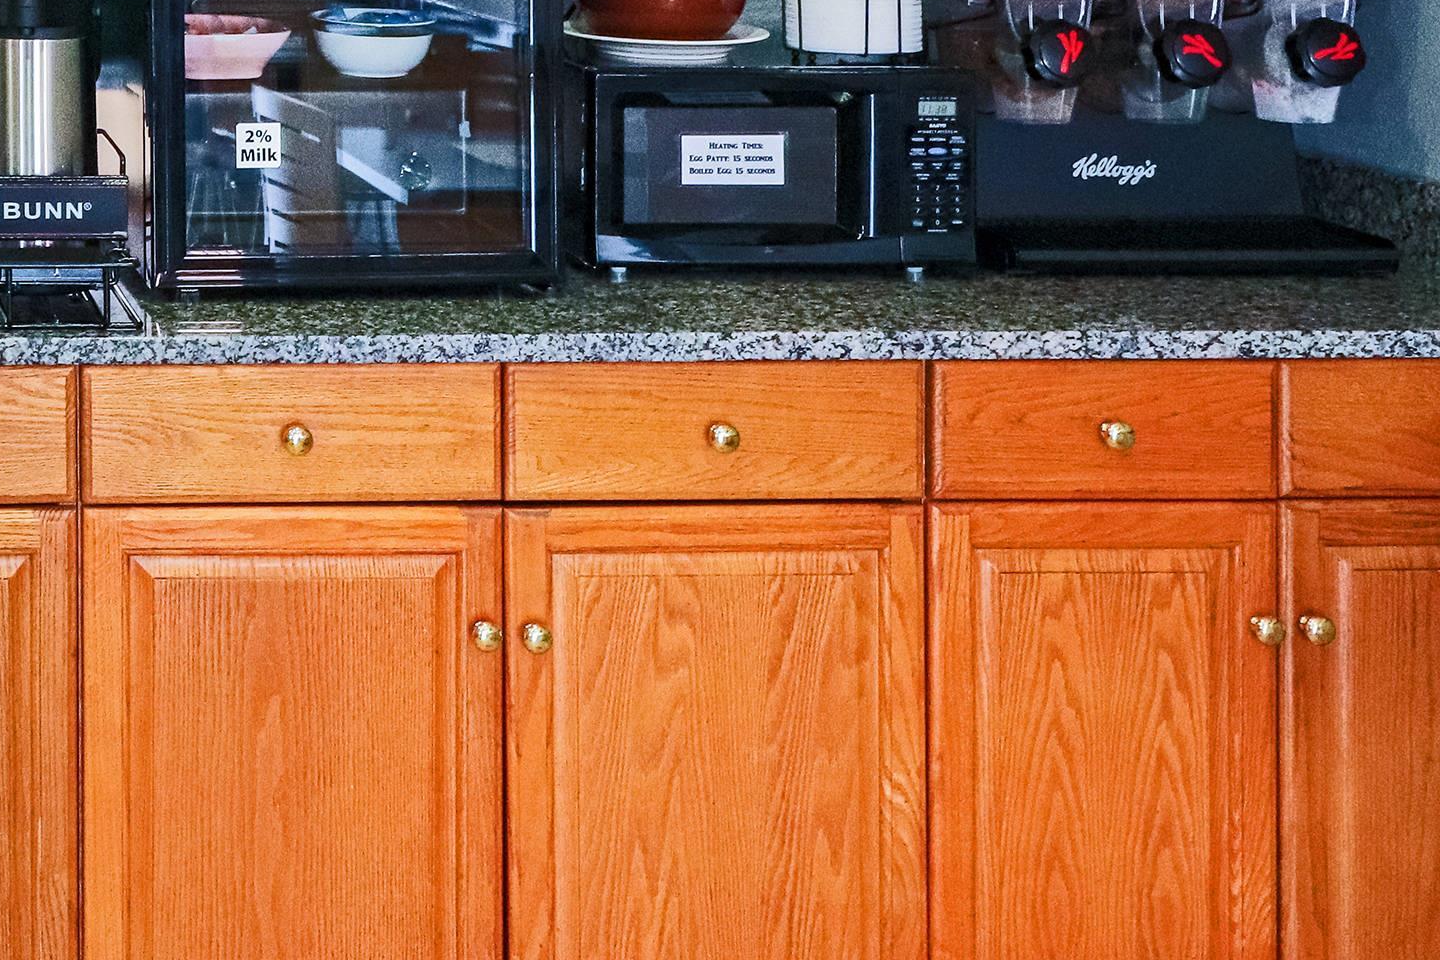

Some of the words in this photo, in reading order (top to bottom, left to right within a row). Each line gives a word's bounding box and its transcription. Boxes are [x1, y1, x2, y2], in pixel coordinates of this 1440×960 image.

[245, 130, 272, 143] 2%
[241, 147, 277, 162] Milk
[735, 167, 744, 175] 15
[1072, 153, 1158, 186] Kellogg's
